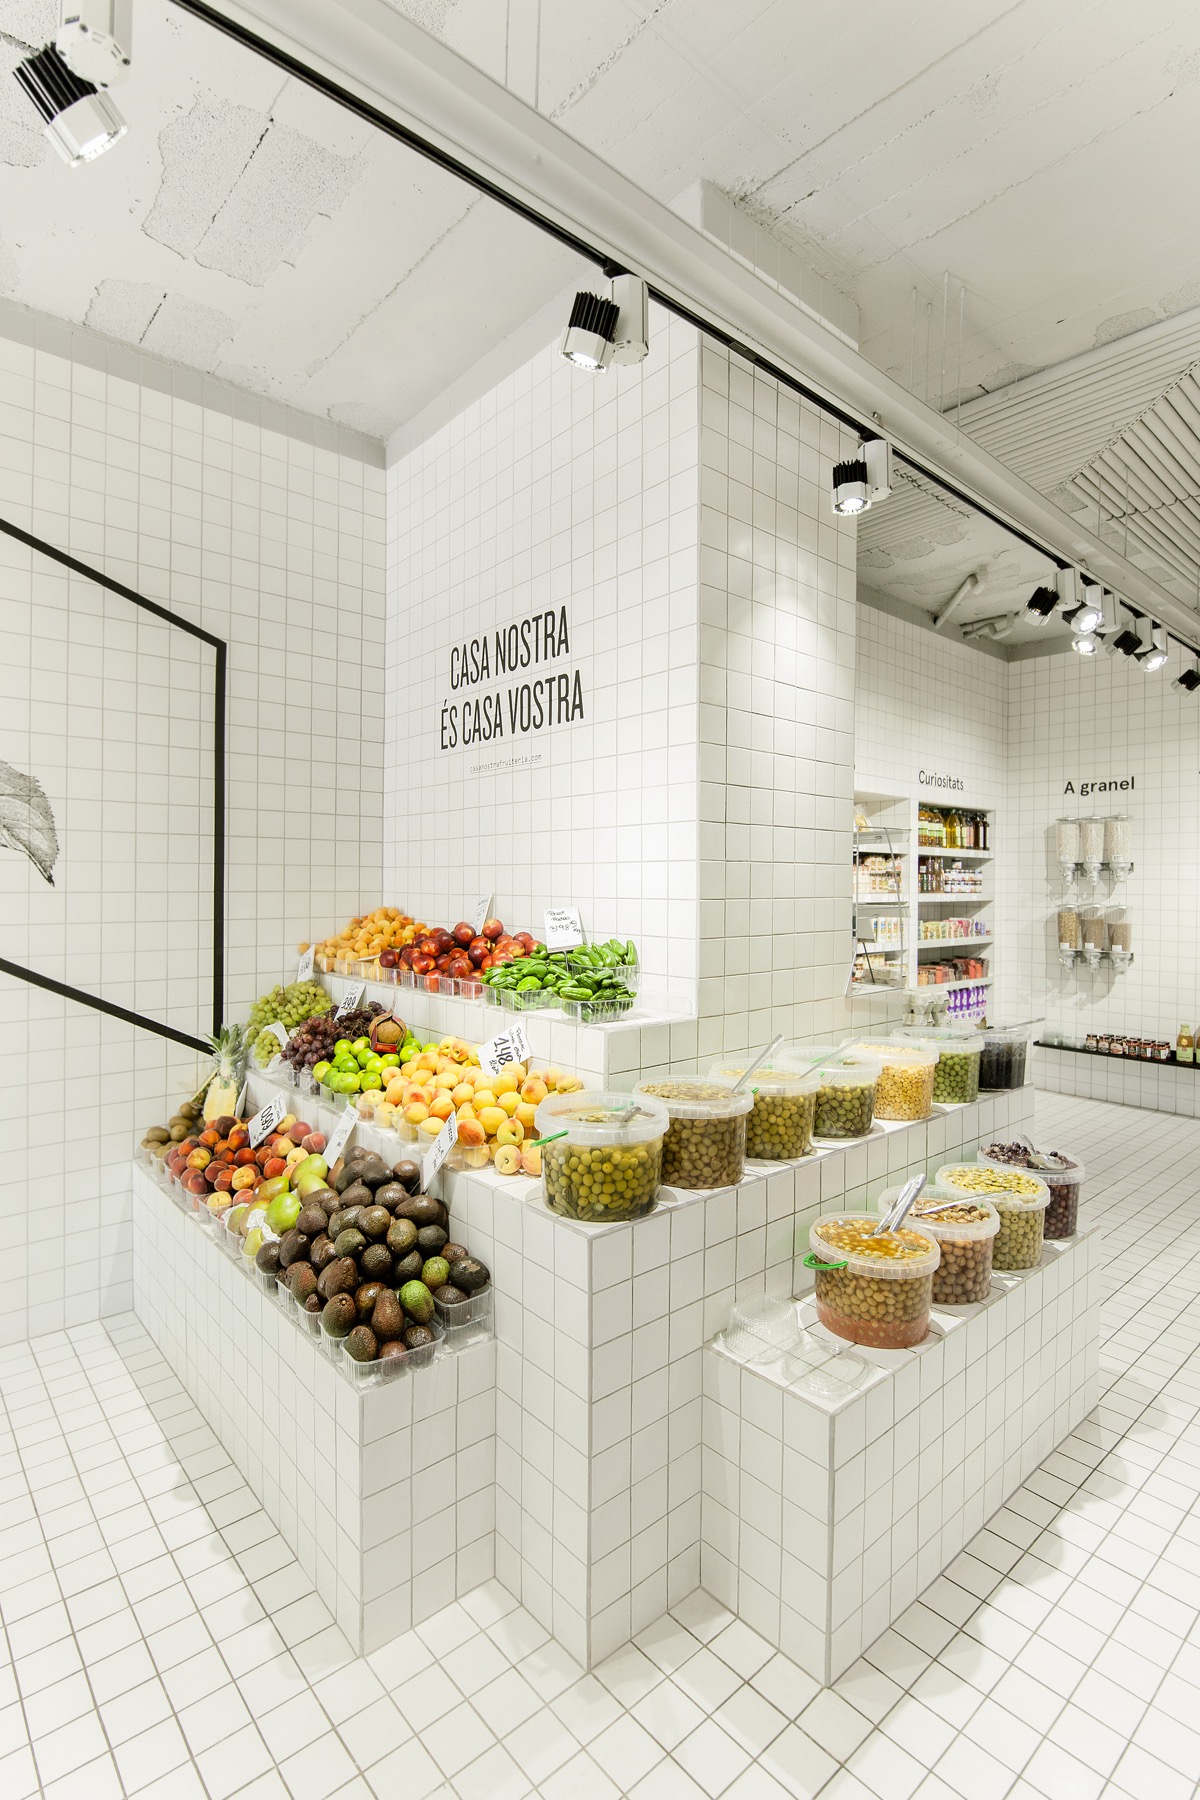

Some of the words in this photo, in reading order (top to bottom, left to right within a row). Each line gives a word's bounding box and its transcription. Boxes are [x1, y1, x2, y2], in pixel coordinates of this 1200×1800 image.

[450, 635, 490, 690] CASA
[495, 605, 570, 677] NOSTRA
[440, 699, 458, 751] ÉS
[462, 692, 504, 746] CASA
[508, 669, 585, 735] VOSTRA
[469, 753, 542, 774] casanostrafruiteria.com
[918, 770, 964, 791] Curiositats
[1064, 780, 1075, 794] A
[1080, 776, 1135, 796] granel
